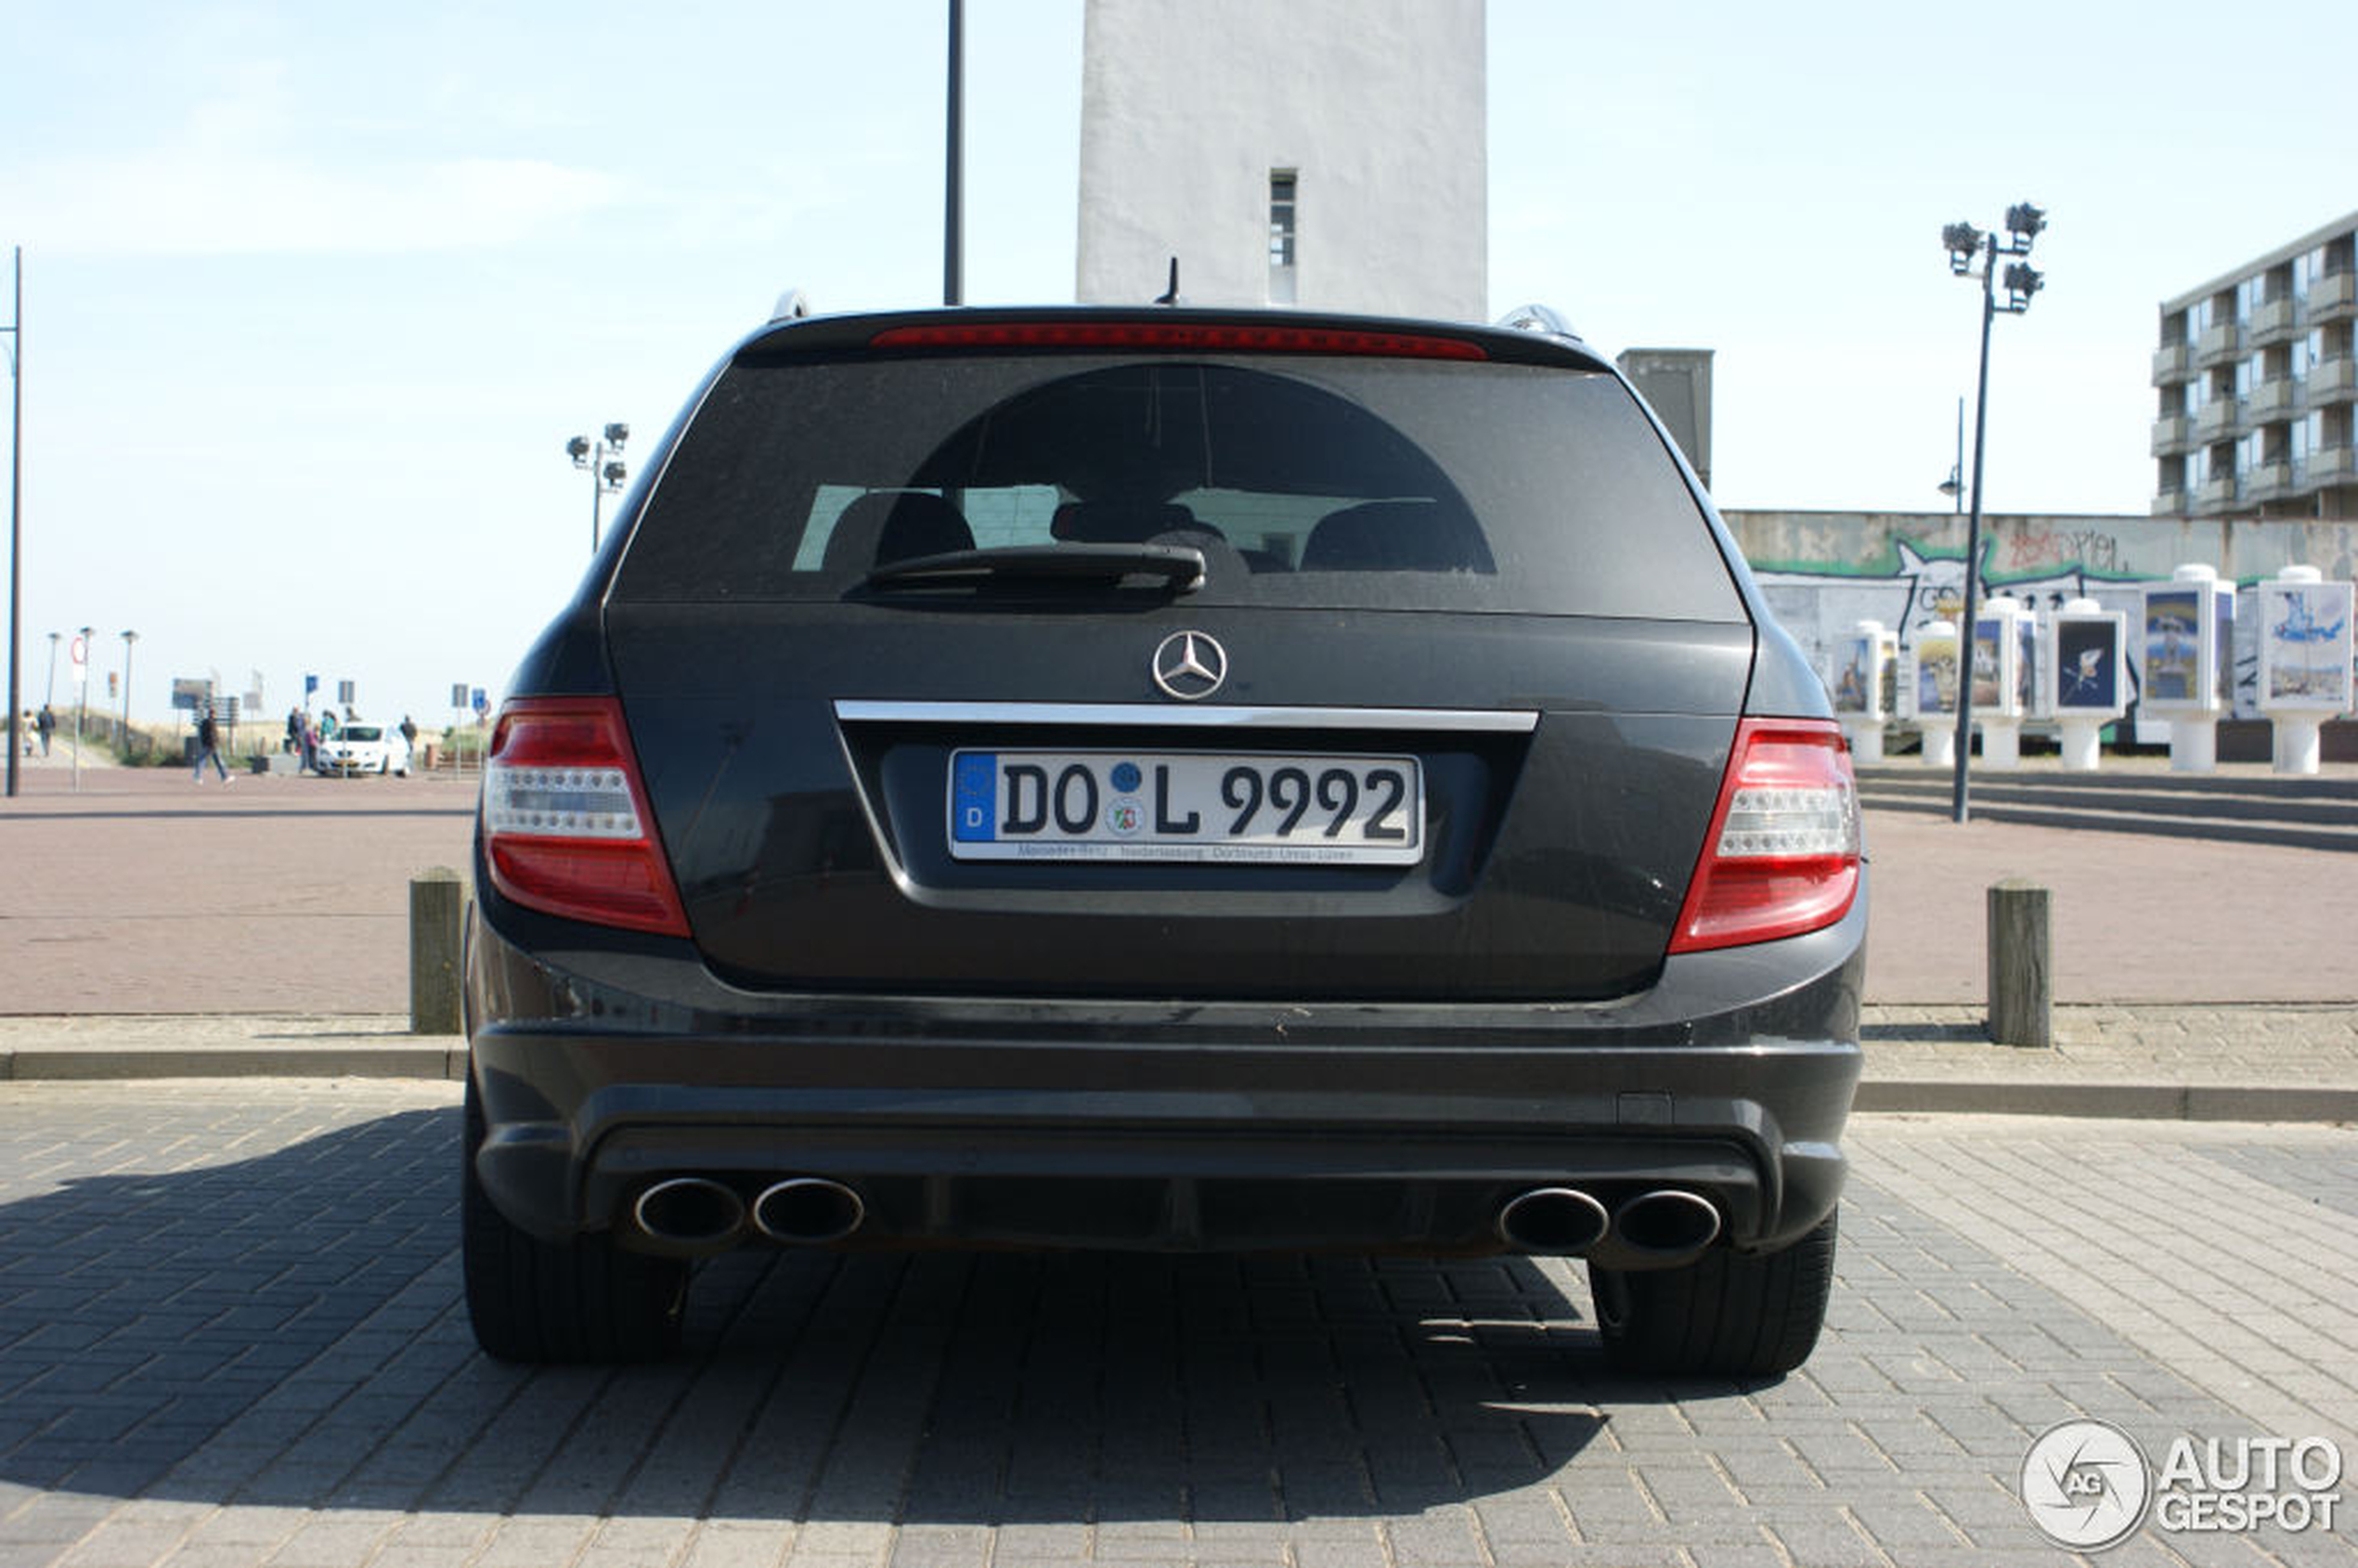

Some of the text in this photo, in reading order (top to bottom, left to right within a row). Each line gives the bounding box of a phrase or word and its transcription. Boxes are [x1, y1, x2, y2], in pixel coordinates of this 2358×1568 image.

[966, 808, 982, 827] D
[1003, 764, 1406, 840] DO L 9992
